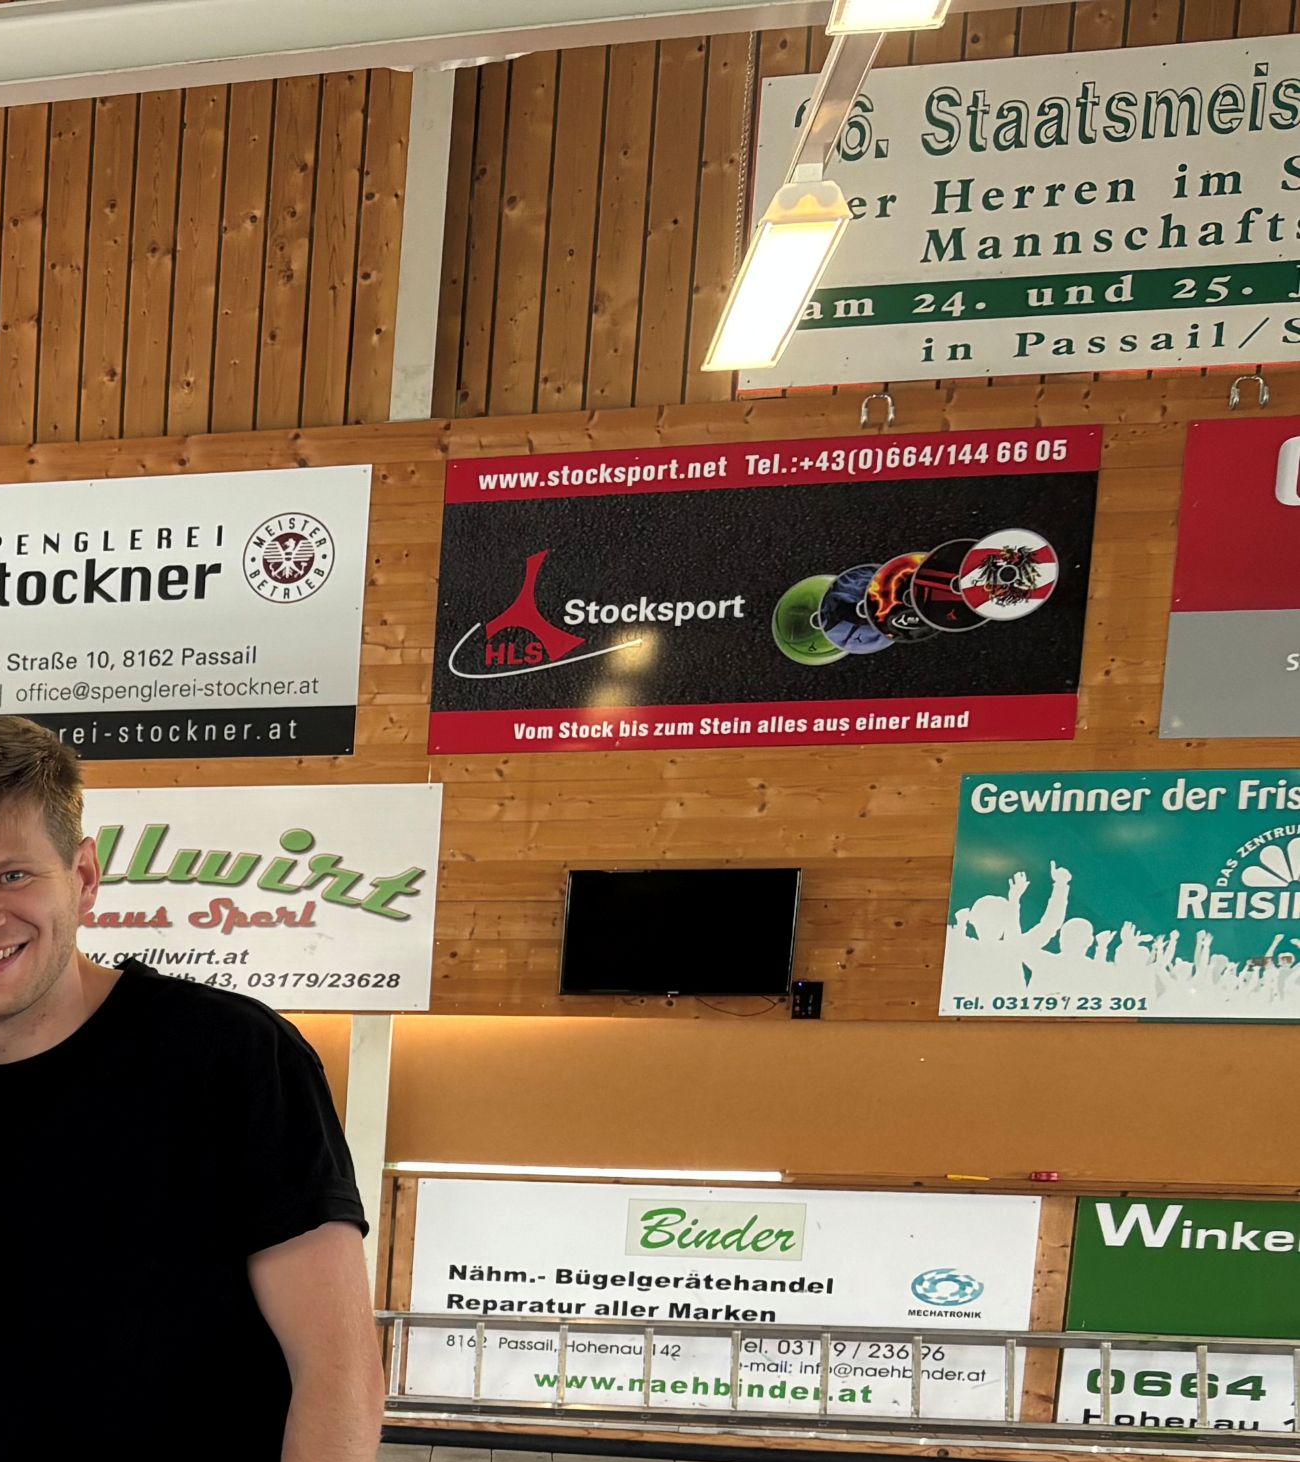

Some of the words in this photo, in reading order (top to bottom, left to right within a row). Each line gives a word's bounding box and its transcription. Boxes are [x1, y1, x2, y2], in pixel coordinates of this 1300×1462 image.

[795, 94, 889, 161] 6.
[847, 194, 897, 220] er
[932, 171, 1136, 216] Herren
[1173, 163, 1242, 200] im
[920, 207, 1300, 264] Mannschaft
[800, 294, 875, 323] am
[912, 291, 986, 316] 24.
[1026, 275, 1135, 309] und
[1172, 275, 1253, 302] 25.
[920, 337, 973, 362] in
[478, 456, 727, 490] www.stocksport.net
[745, 442, 989, 476] Tel.:+43(0)664/144
[996, 441, 1028, 463] 66
[1035, 439, 1068, 461] 05
[253, 517, 327, 549] MEISTER
[249, 568, 325, 599] BETRIEB
[563, 594, 746, 626] Stocksport
[7, 652, 77, 672] Straße
[87, 651, 115, 670] 10,
[123, 650, 173, 668] 8162
[182, 646, 257, 666] Passail
[485, 642, 543, 666] HLS
[16, 676, 319, 705] office@spenglerei-stockner.at
[513, 723, 553, 740] Vom
[559, 721, 613, 739] Stock
[619, 720, 649, 738] bis
[654, 722, 694, 737] zum
[699, 717, 751, 736] Stein
[757, 715, 807, 734] alles
[813, 718, 850, 732] aus
[855, 714, 910, 731] einer
[915, 711, 970, 730] Hand
[971, 782, 1151, 814] Gewinner
[1162, 778, 1227, 811] der
[1216, 858, 1238, 887] DAS
[1236, 824, 1300, 858] ZENTRU
[204, 973, 237, 989] 43,
[247, 972, 400, 989] 03179/23628
[953, 997, 984, 1010] Tel.
[993, 997, 1058, 1010] 03179
[1077, 997, 1102, 1010] 23
[1109, 997, 1148, 1010] 301
[639, 1207, 798, 1254] Binder
[1095, 1203, 1300, 1252] Winke
[448, 1264, 546, 1283] Nähm.-
[555, 1268, 834, 1294] Bügelgerätehandel
[446, 1293, 585, 1315] Reparatur
[594, 1301, 659, 1318] aller
[668, 1302, 776, 1322] Marken
[908, 1309, 982, 1319] MECHATRONIK
[498, 1336, 558, 1353] Passail,
[1087, 1368, 1267, 1401] 0664
